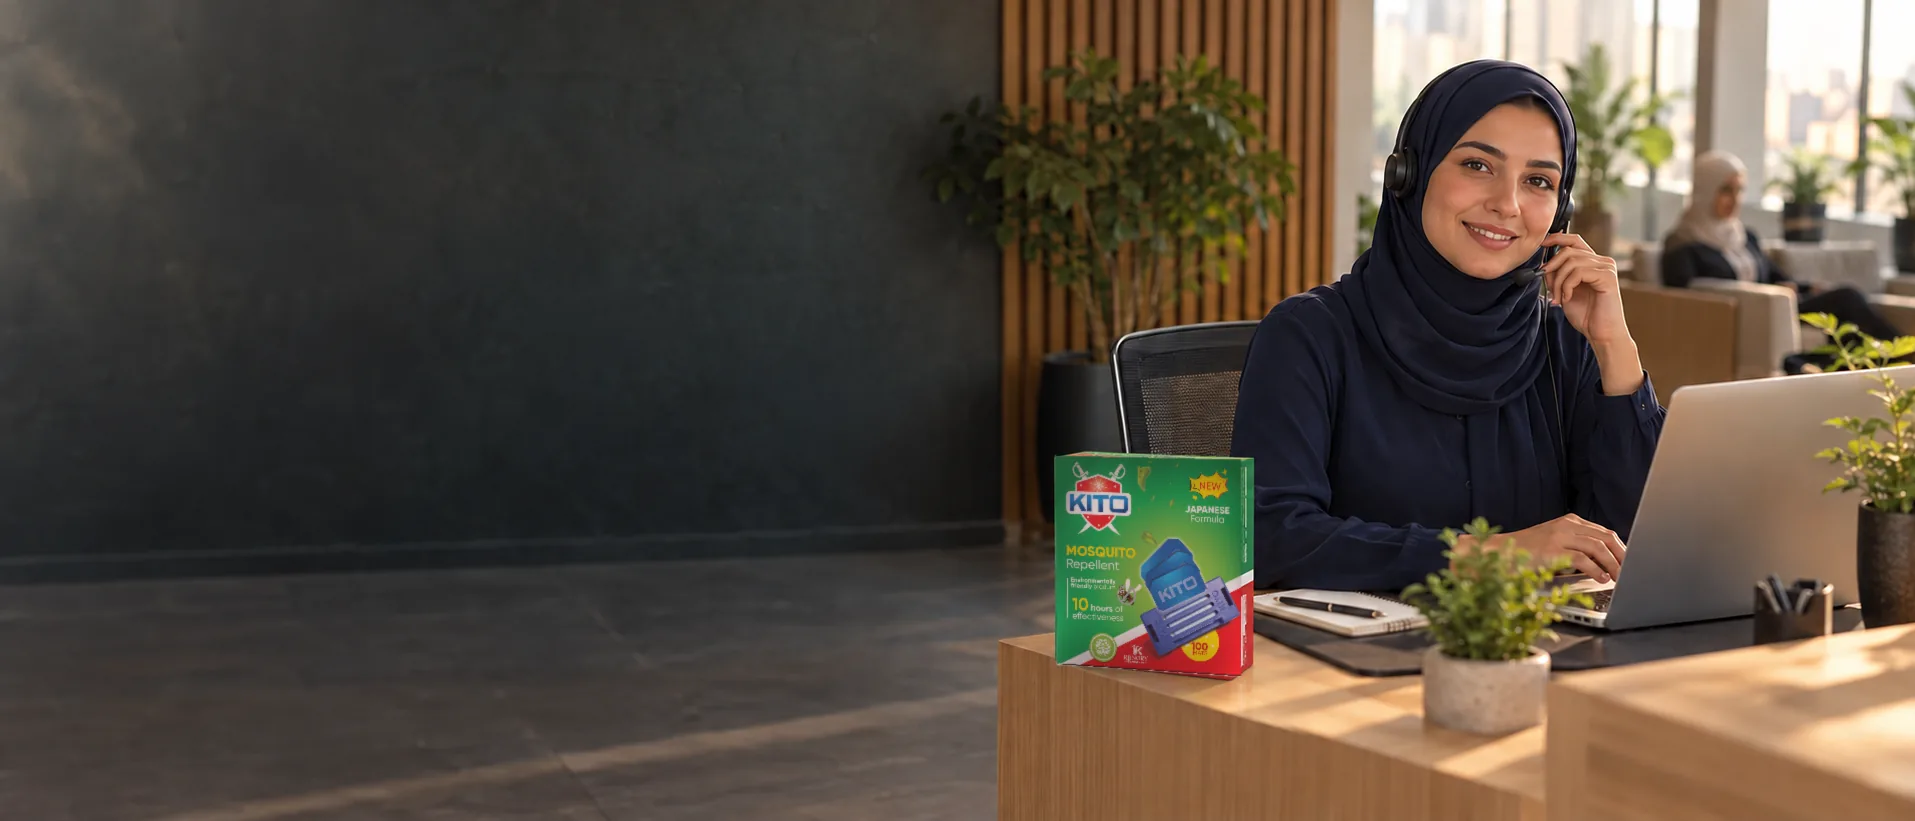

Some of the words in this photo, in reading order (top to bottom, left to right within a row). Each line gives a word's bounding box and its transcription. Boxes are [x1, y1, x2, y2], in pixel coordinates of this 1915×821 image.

[1199, 481, 1221, 491] NEW
[1069, 494, 1129, 513] KITO
[1185, 505, 1230, 515] JAPANESE
[1190, 514, 1225, 524] Formula
[1066, 545, 1137, 559] MOSQUITO
[1066, 558, 1120, 571] Repellent
[1157, 575, 1198, 603] KITO
[1072, 597, 1089, 612] 10
[1090, 604, 1114, 613] hours
